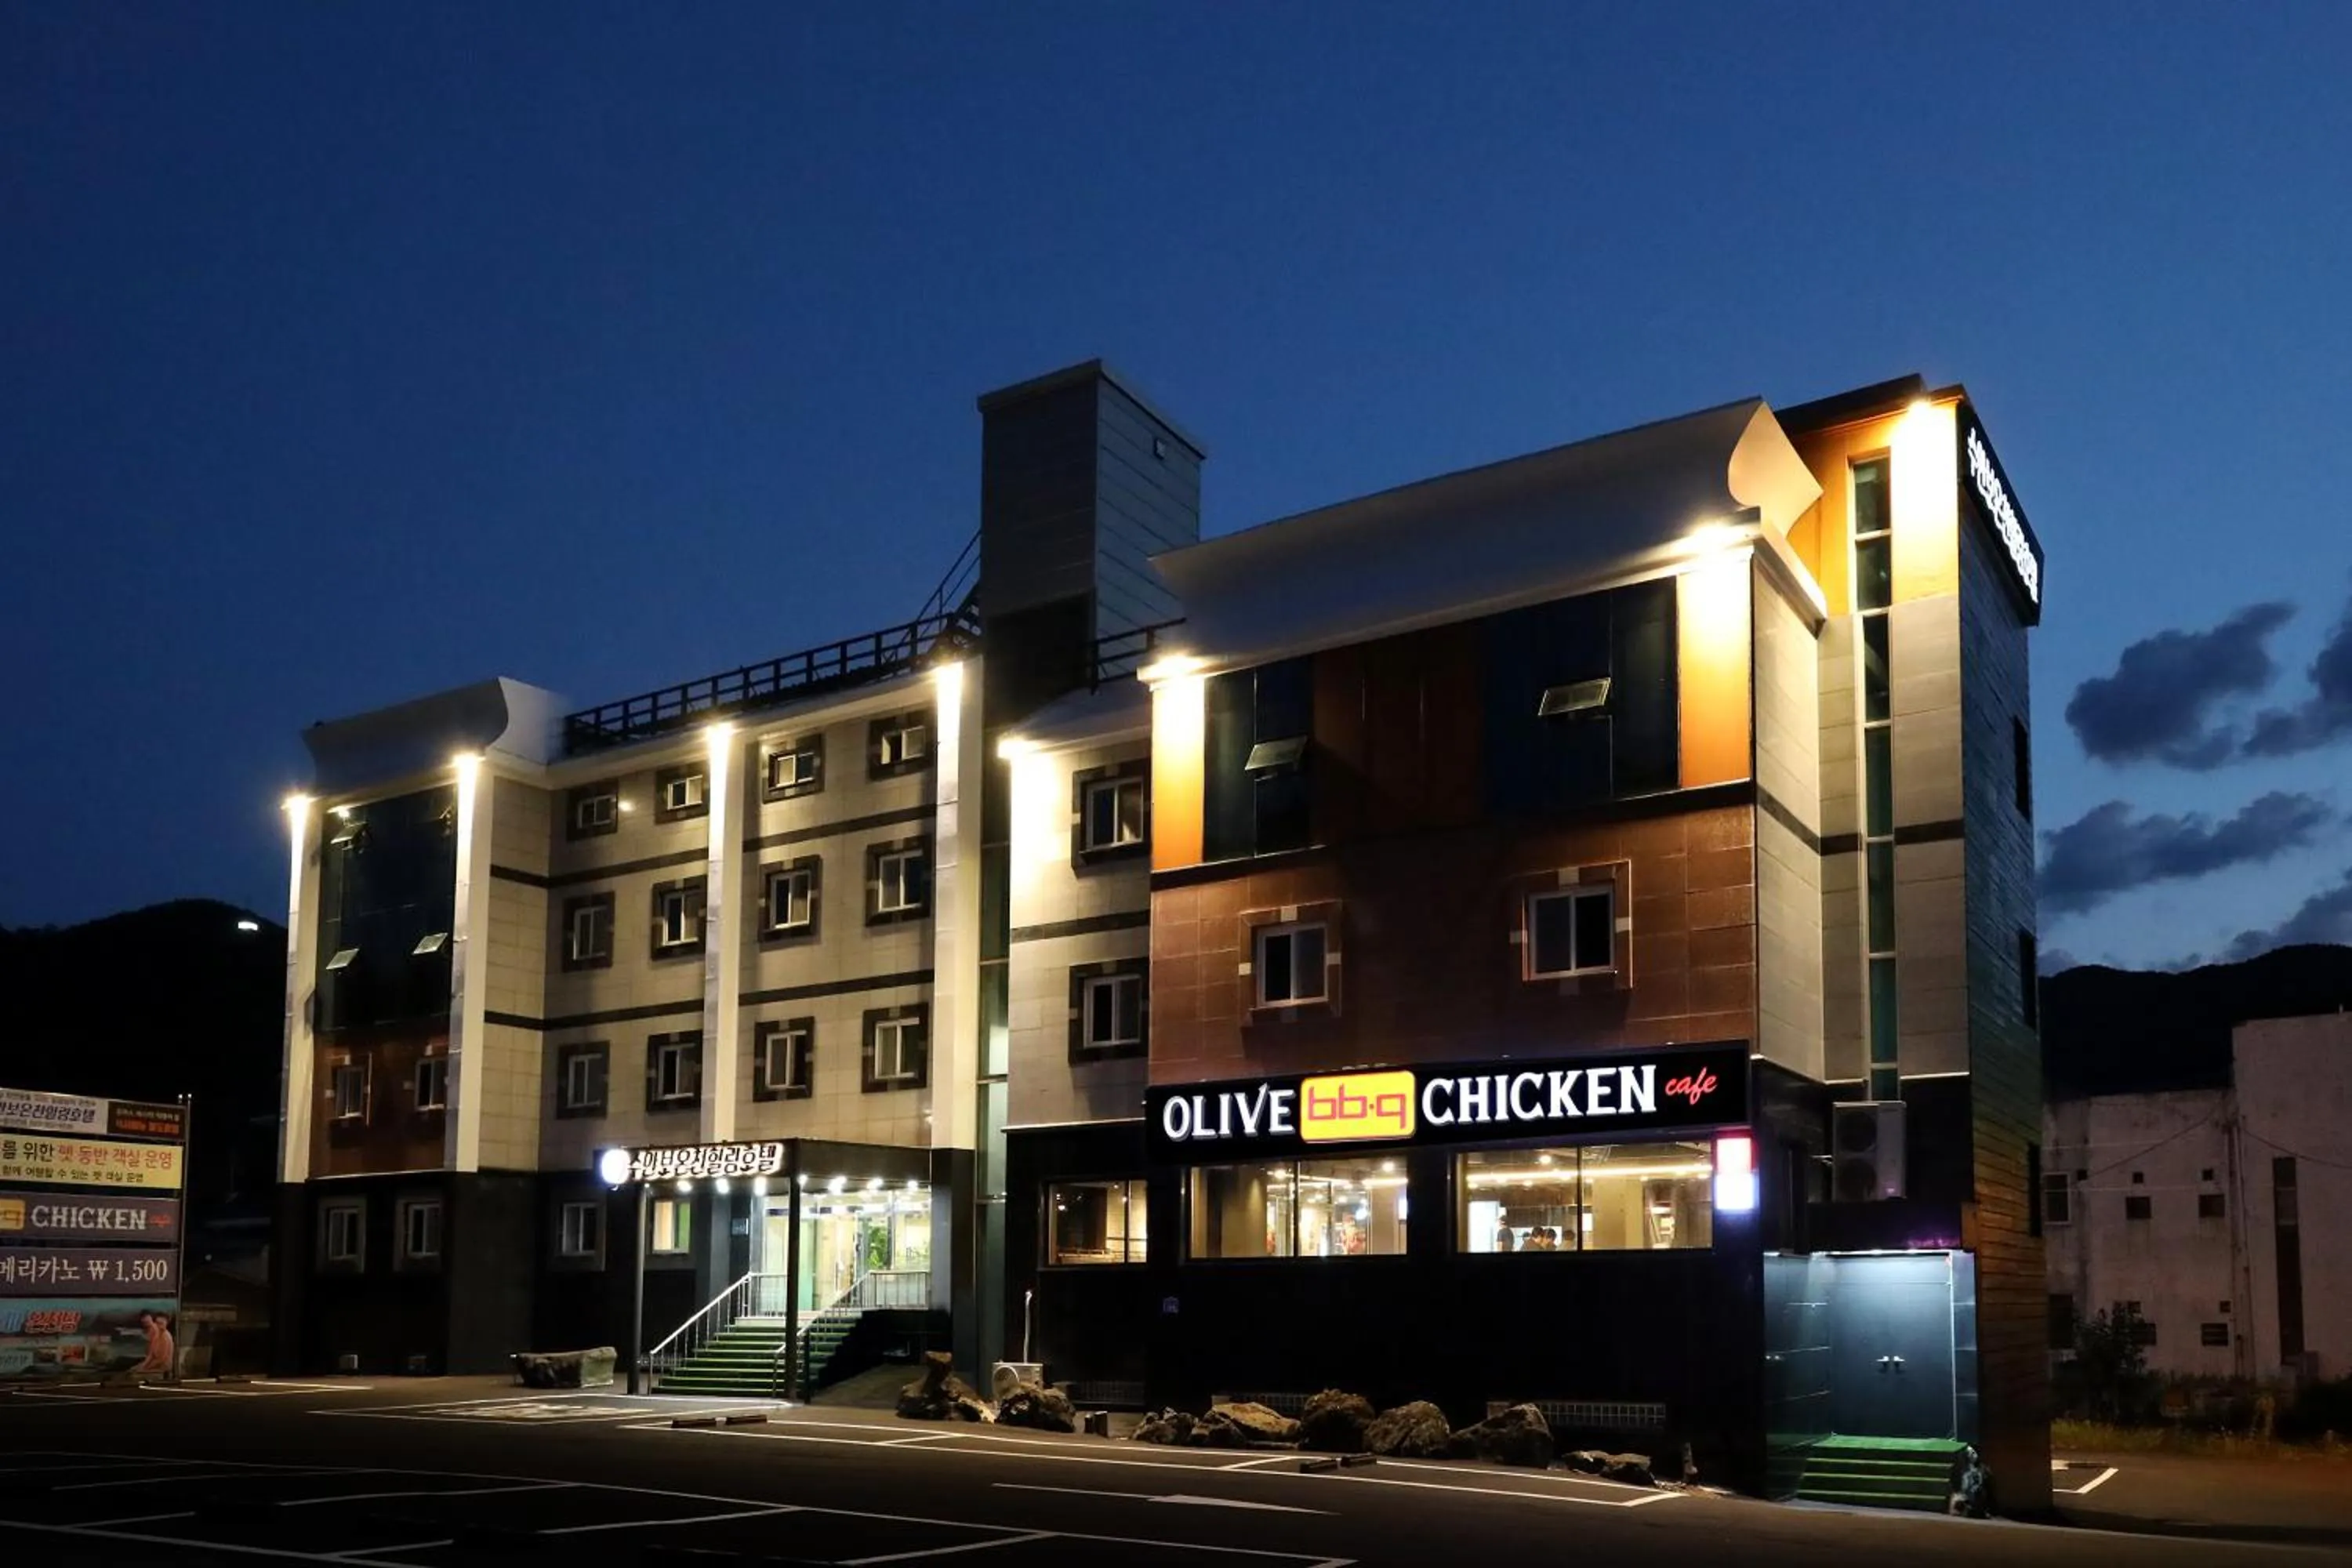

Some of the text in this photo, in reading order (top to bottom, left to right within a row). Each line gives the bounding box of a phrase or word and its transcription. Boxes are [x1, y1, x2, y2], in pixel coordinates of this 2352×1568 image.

[1163, 1083, 1294, 1139] OLIVE
[1421, 1065, 1657, 1125] CHICKEN
[1664, 1066, 1718, 1105] cafe
[23, 1142, 54, 1162] 위한
[79, 1145, 108, 1166] 동반
[112, 1148, 140, 1168] 객실
[144, 1149, 172, 1170] 운영
[31, 1205, 148, 1230] CHICKEN
[0, 1255, 80, 1284] 메리카노
